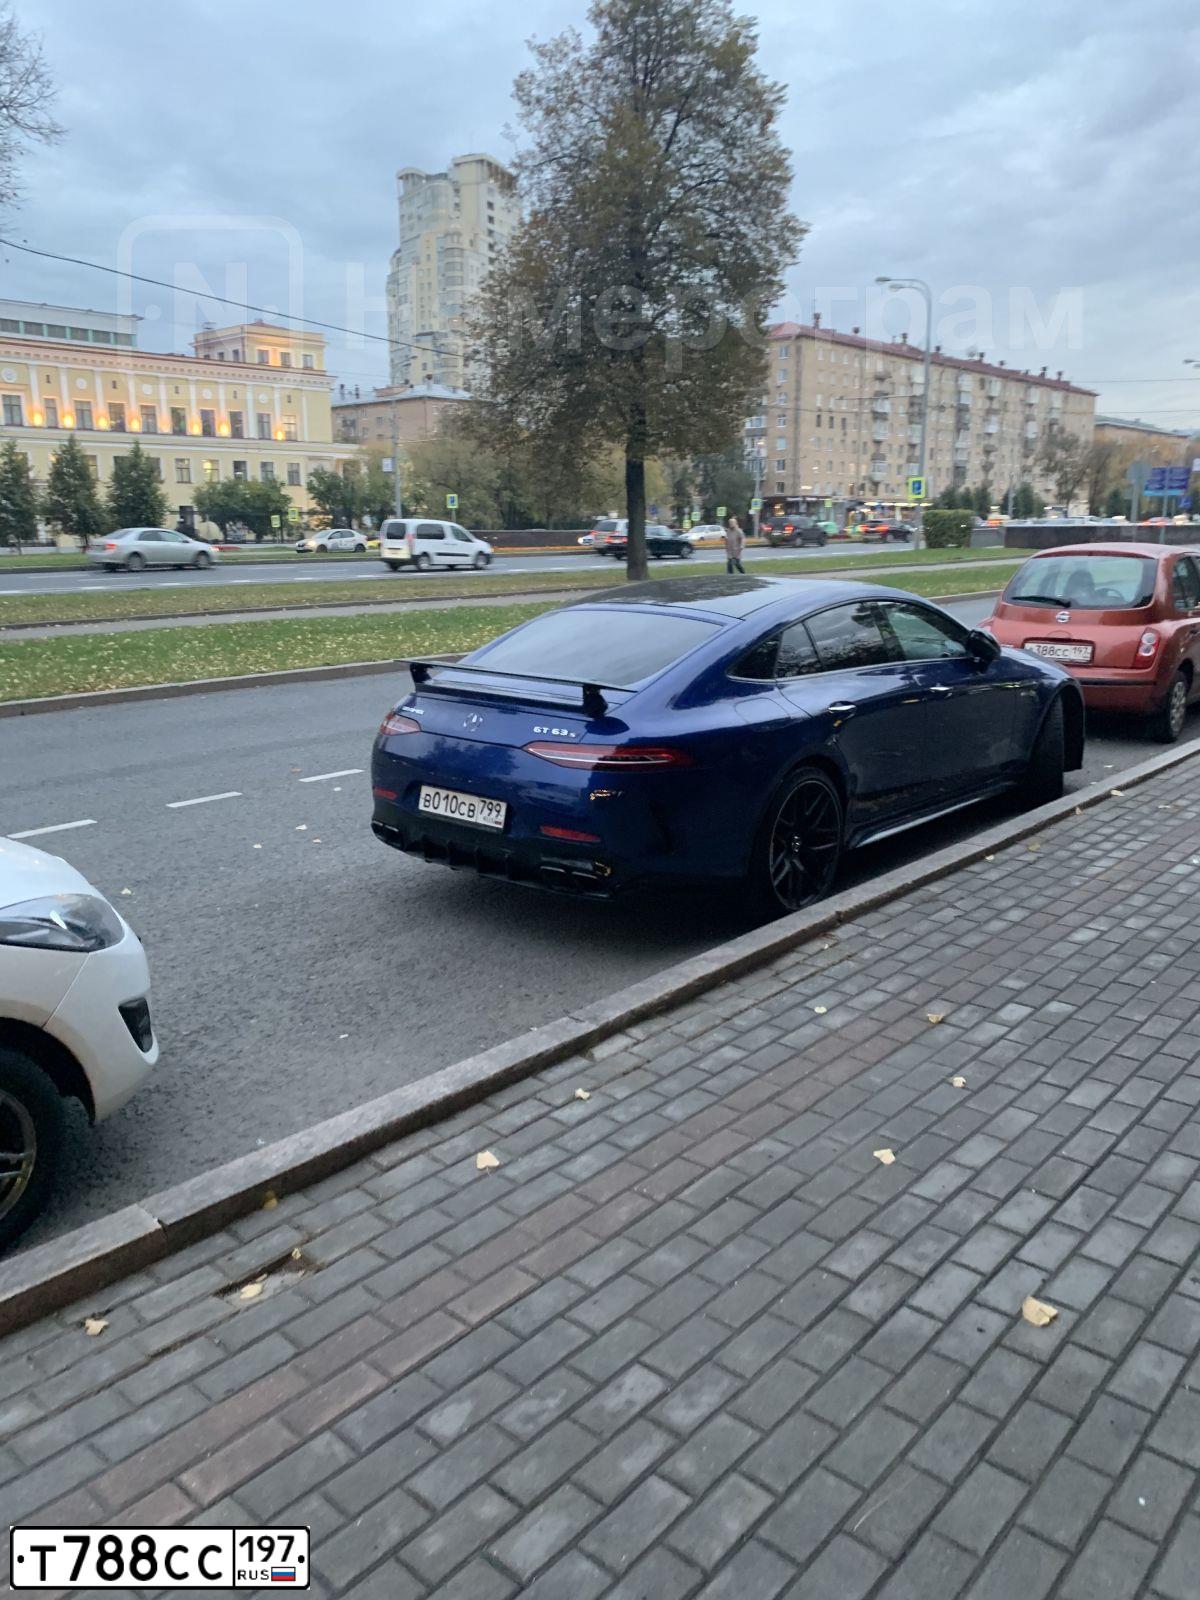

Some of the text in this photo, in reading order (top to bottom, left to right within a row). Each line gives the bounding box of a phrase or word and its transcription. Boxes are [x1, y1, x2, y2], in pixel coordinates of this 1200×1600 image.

[533, 726, 550, 734] GT
[551, 728, 569, 736] 63
[423, 791, 502, 818] В010СВ 799
